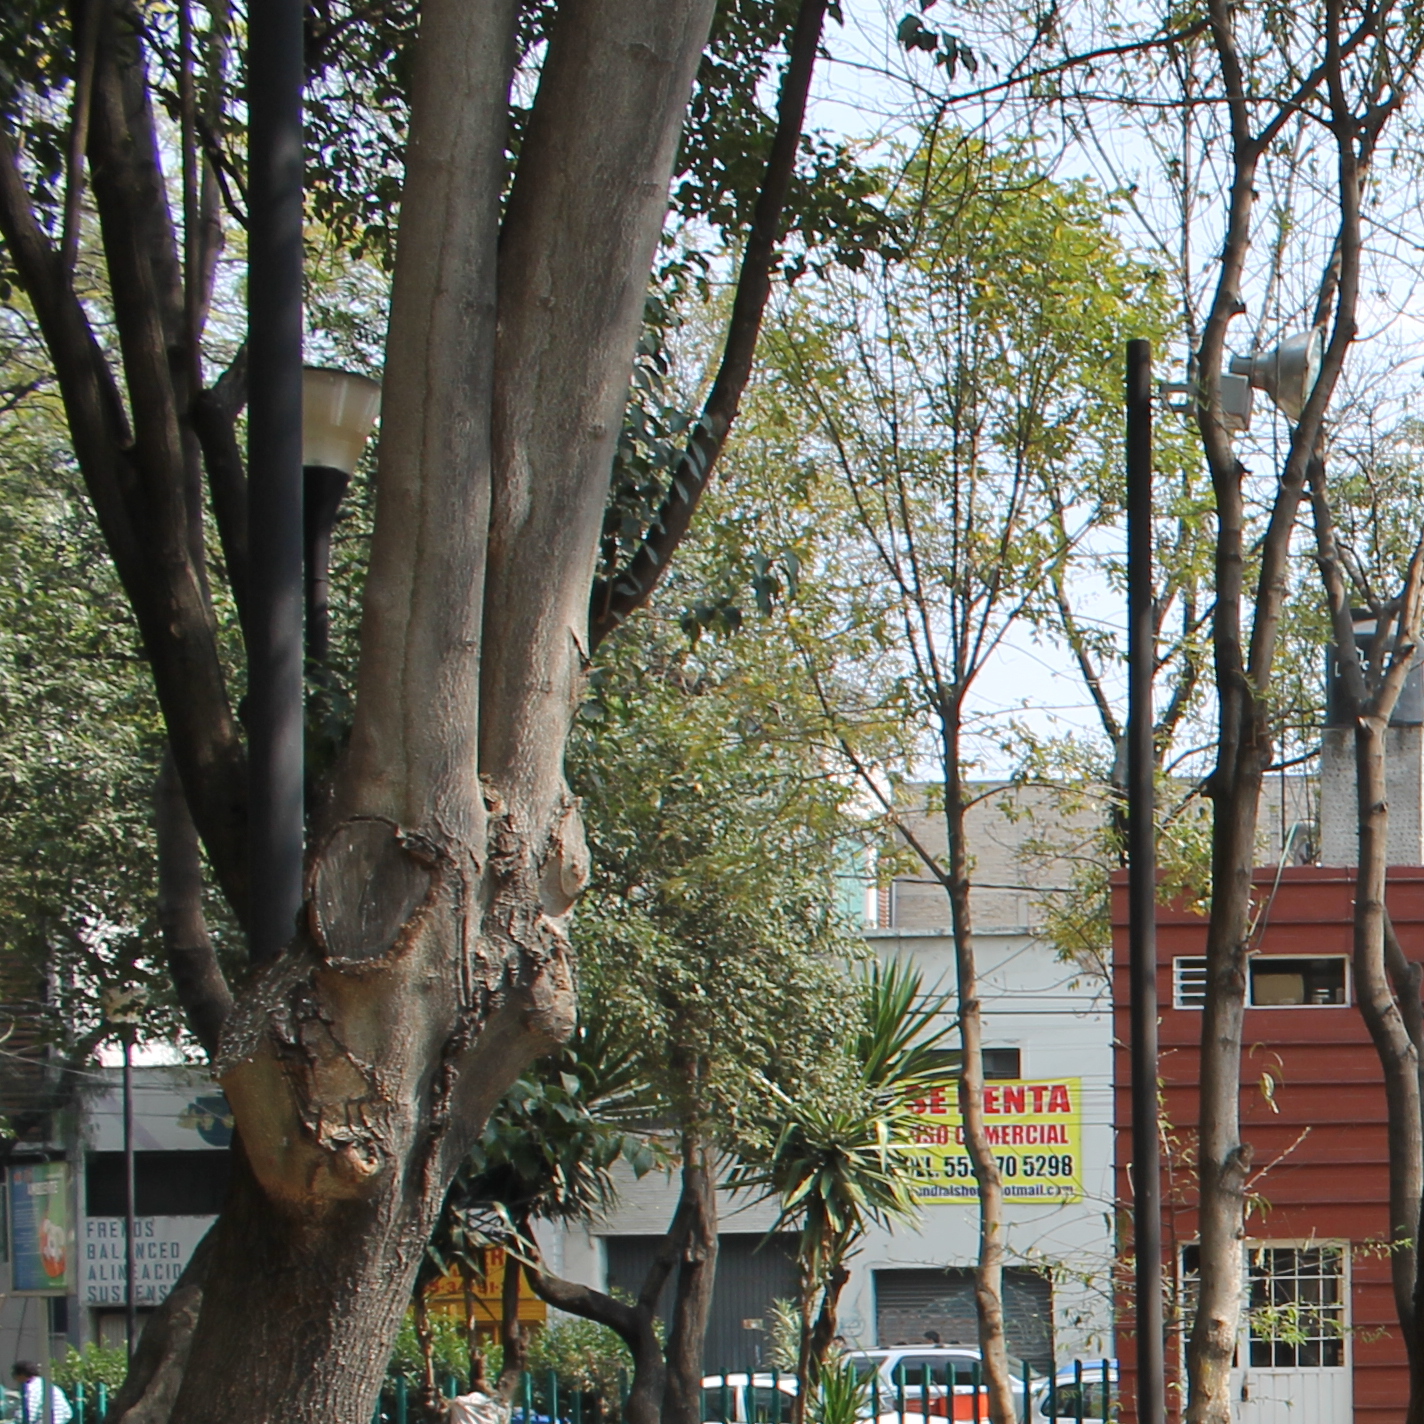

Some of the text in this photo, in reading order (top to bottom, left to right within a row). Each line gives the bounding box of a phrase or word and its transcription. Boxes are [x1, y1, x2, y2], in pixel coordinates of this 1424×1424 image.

[959, 1085, 1071, 1114] ENTA
[955, 1124, 1068, 1145] CMERCIAL
[1024, 1155, 1072, 1177] 5298
